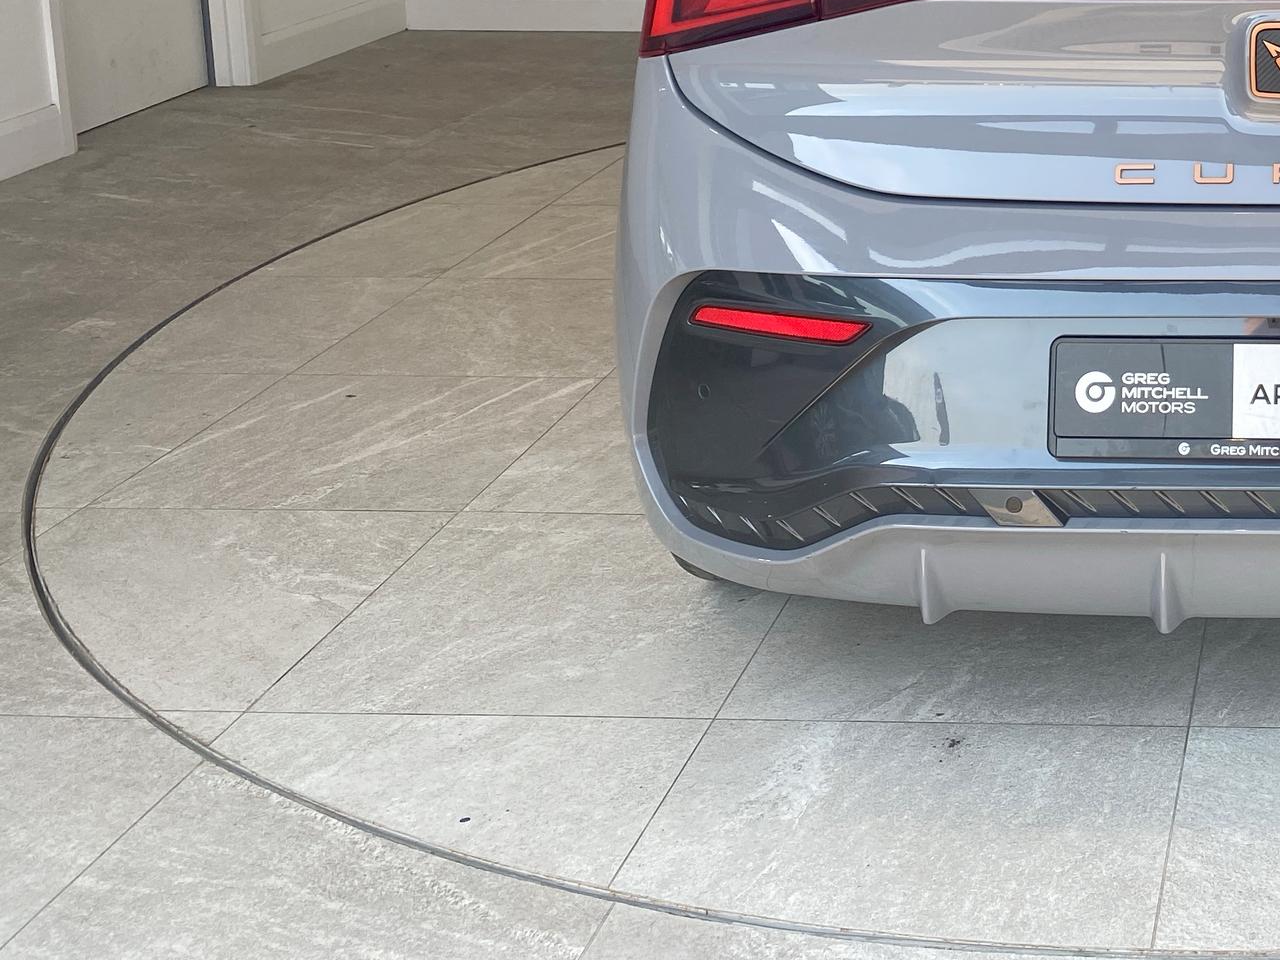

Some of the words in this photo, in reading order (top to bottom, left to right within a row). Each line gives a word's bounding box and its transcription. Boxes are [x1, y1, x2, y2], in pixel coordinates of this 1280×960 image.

[1121, 372, 1171, 385] GREG
[1121, 386, 1209, 400] MITCHELL
[1121, 401, 1196, 414] MOTORS
